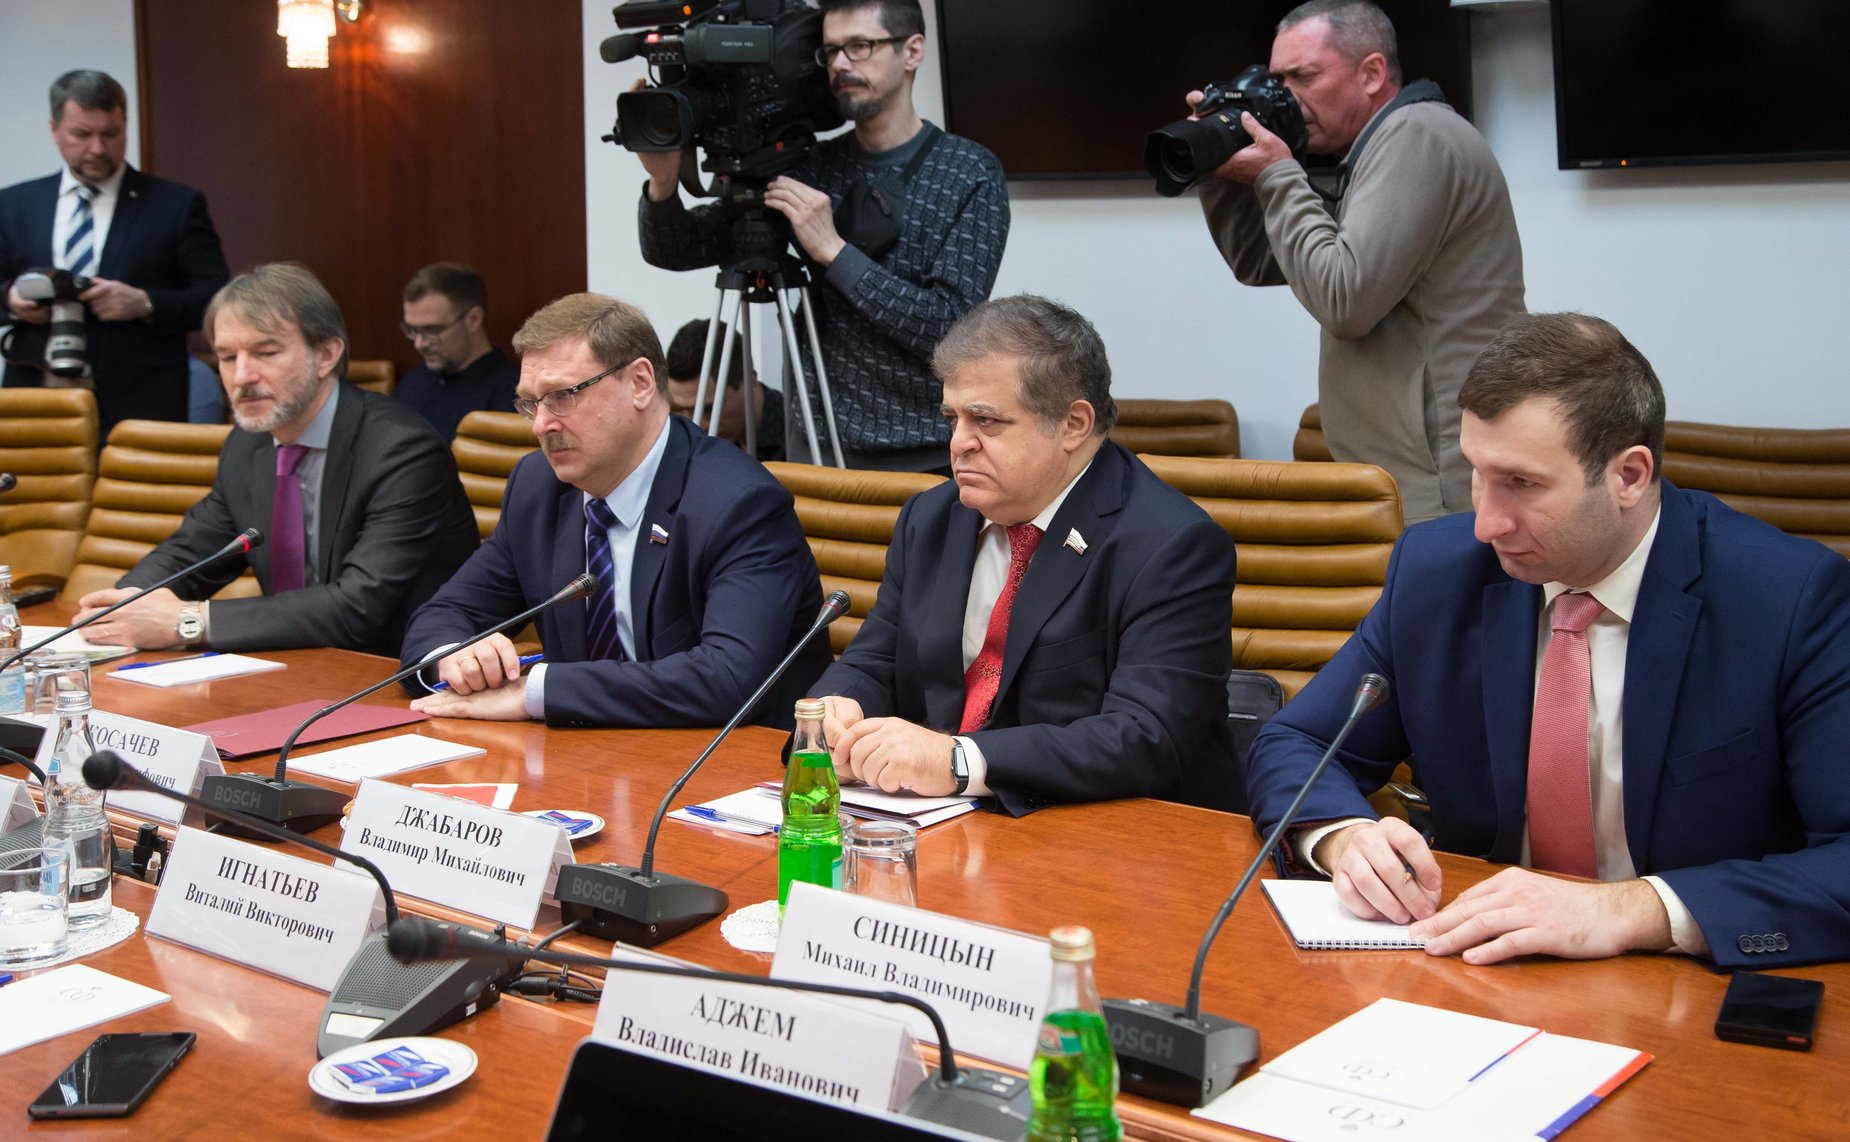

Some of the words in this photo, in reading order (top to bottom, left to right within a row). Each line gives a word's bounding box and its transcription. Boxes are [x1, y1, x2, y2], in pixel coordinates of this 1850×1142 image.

[214, 785, 262, 808] BOSCH
[395, 804, 503, 848] ДЖАБАРОВ
[217, 856, 320, 903] ИГНАТЬЕВ
[359, 827, 428, 864] Владимир
[431, 846, 526, 886] Михайлович
[185, 882, 244, 916] Виталий
[245, 901, 334, 943] Викторович
[572, 877, 626, 907] BOSCH
[853, 915, 997, 972] СИНИЦЫН
[803, 941, 877, 978] Михаил
[883, 962, 1035, 1021] Владимирович
[690, 993, 797, 1042] АДЖЕМ
[1110, 1022, 1174, 1058] OSCH
[617, 1016, 733, 1070] Владислав
[740, 1049, 860, 1104] Иванович
